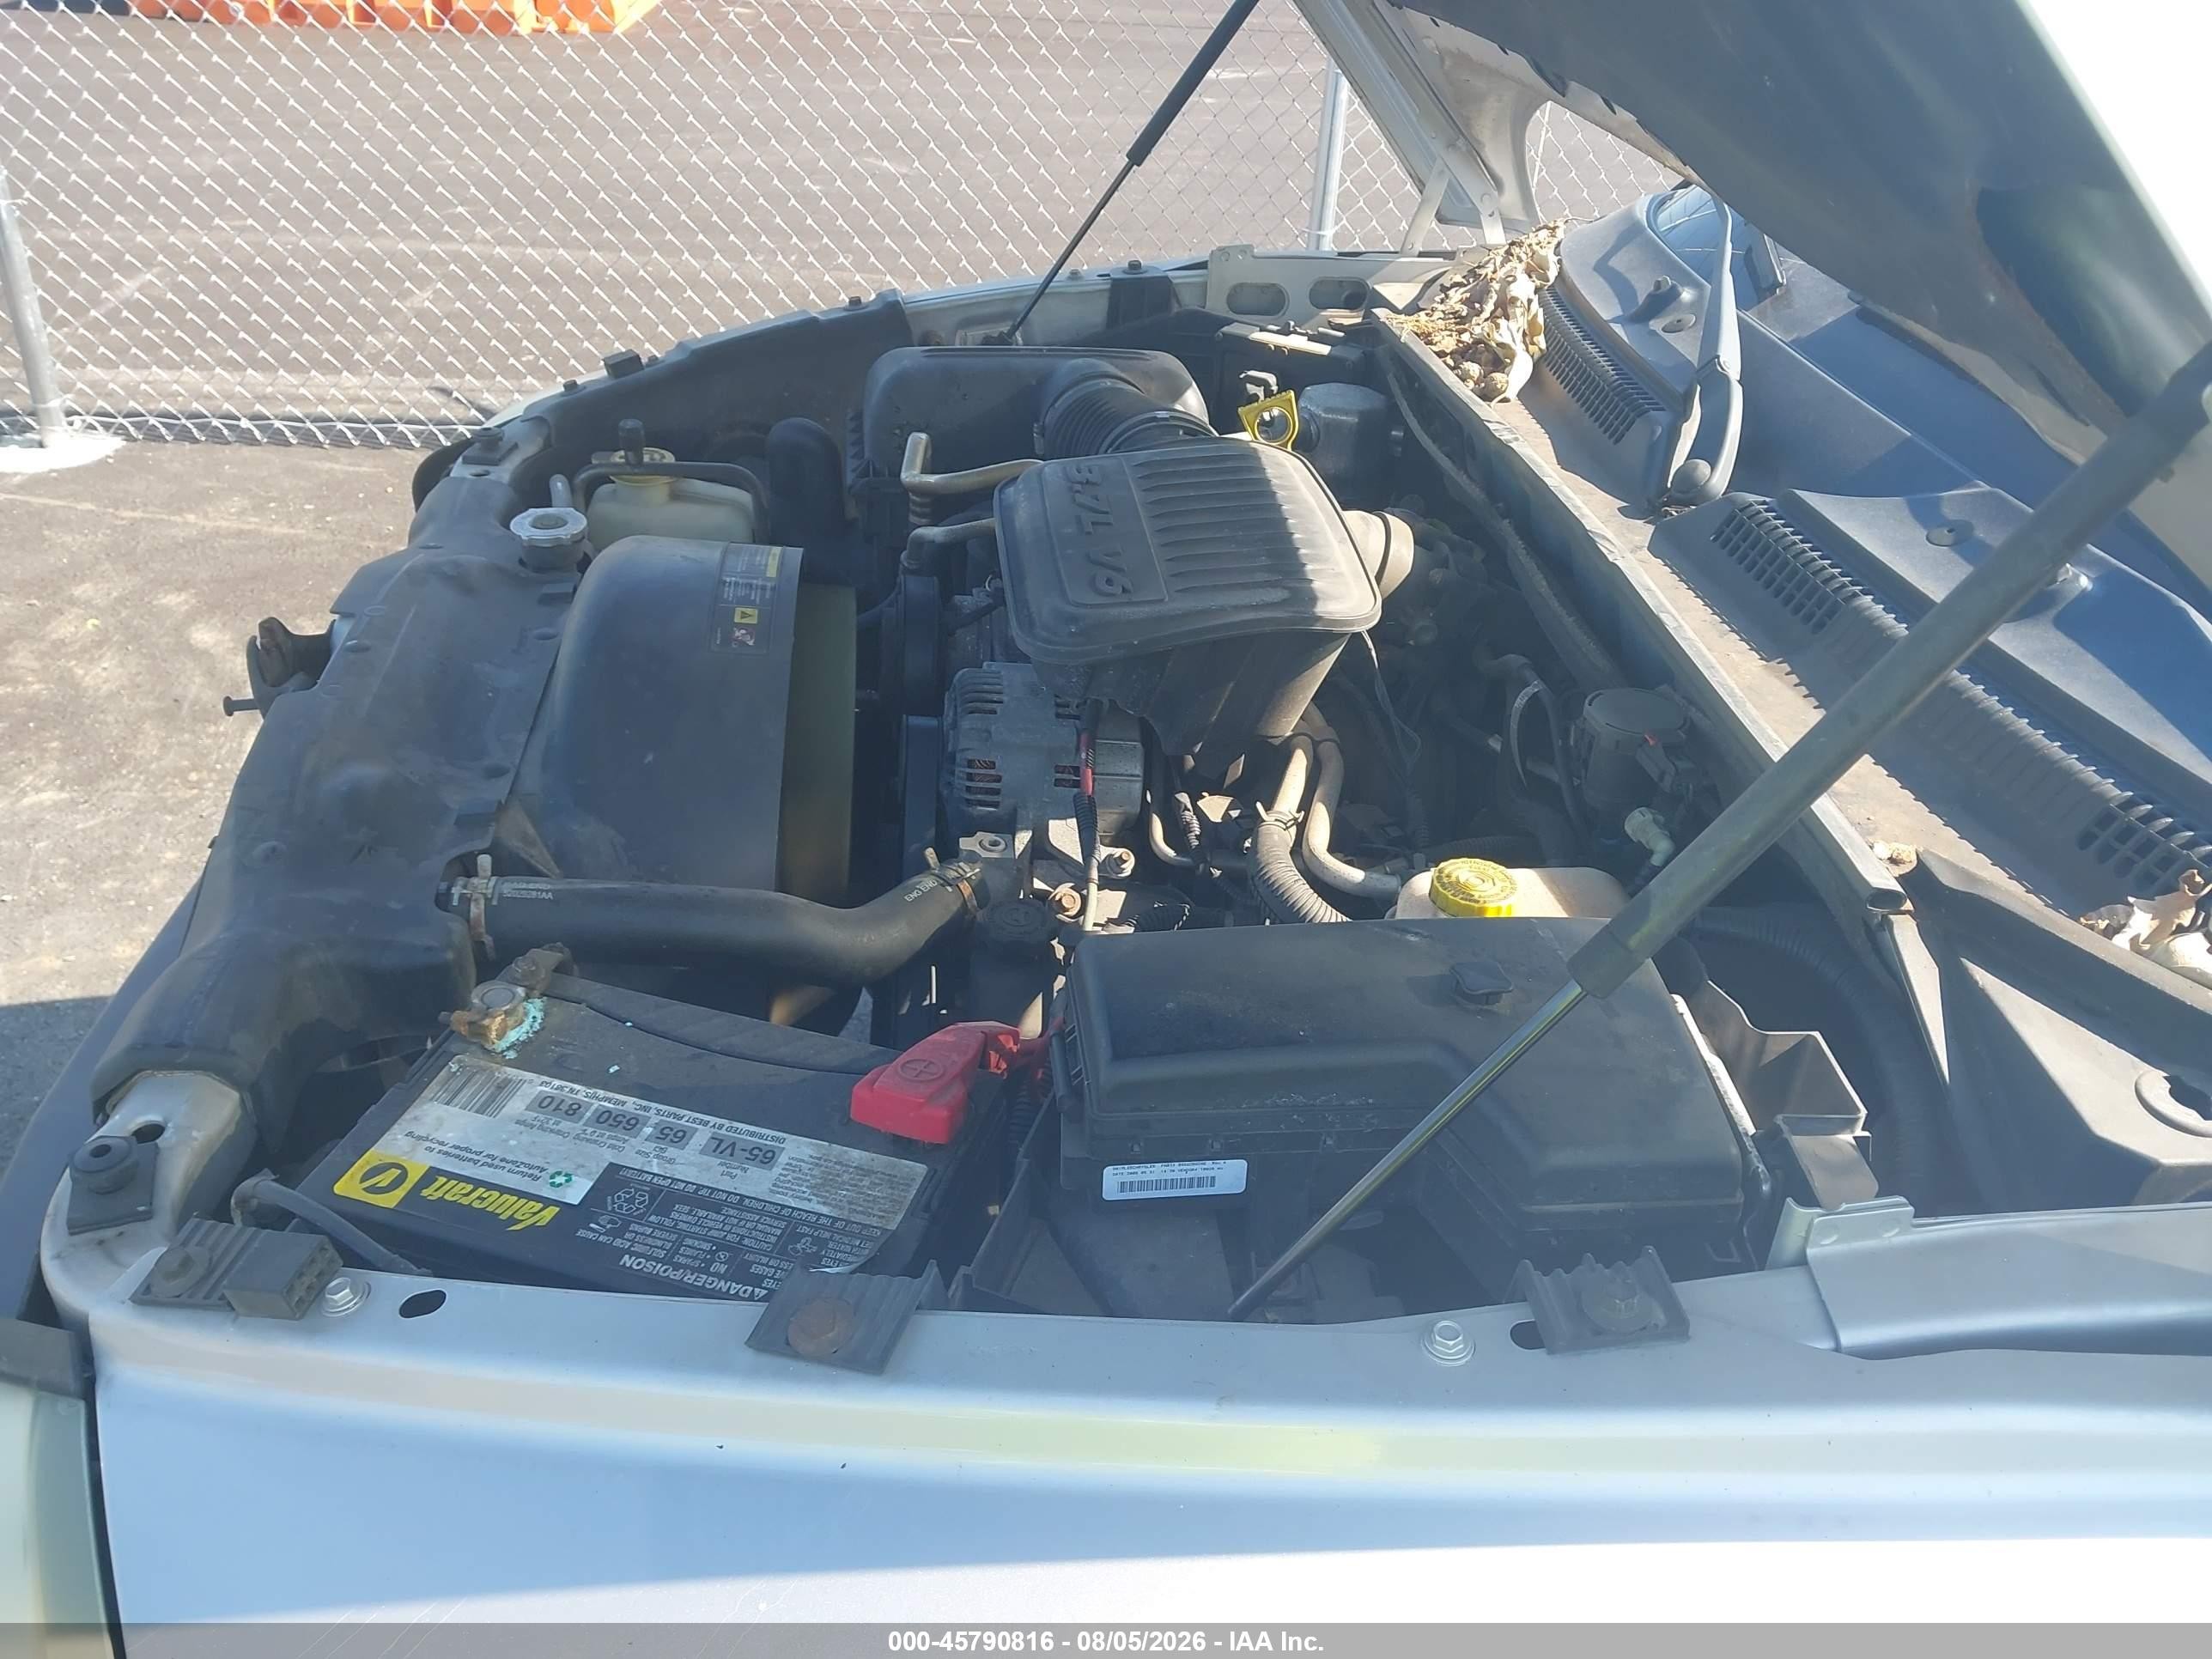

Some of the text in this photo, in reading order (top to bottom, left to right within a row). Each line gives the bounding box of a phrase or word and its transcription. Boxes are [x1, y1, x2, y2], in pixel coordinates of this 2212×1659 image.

[1066, 466, 1133, 596] 3.7L V6
[903, 877, 938, 902] ENG END
[538, 1079, 568, 1092] 38103
[565, 1086, 580, 1096] TN
[535, 1093, 584, 1117] 810
[650, 1105, 685, 1121] PARTS,
[592, 1108, 641, 1132] 650
[684, 1115, 710, 1127] BEST
[708, 1120, 726, 1130] BY
[654, 1124, 689, 1145] 65
[724, 1124, 787, 1144] DISTRIBUTED
[402, 1129, 548, 1174] AutoZone for proper recycling
[607, 1142, 626, 1152] Cold
[703, 1135, 778, 1165] 65-VL
[634, 1148, 677, 1164] Group Size
[422, 1145, 543, 1182] Return used batteries to
[716, 1160, 750, 1173] Number
[651, 1176, 672, 1186] OPEN
[719, 1170, 738, 1180] Part
[684, 1183, 696, 1192] DO
[710, 1190, 728, 1200] NOT
[726, 1194, 740, 1203] DO
[420, 1176, 559, 1231] Valucraft
[779, 1206, 793, 1216] OF
[791, 1210, 818, 1222] REACH
[647, 1213, 676, 1226] FOLLOW
[816, 1215, 833, 1225] THE
[832, 1219, 846, 1229] OF
[844, 1222, 862, 1232] OUT
[860, 1226, 882, 1237] KEEP
[574, 1228, 600, 1240] CAUSE
[597, 1234, 614, 1243] CAN
[623, 1231, 636, 1239] OR
[725, 1232, 741, 1242] FOR
[611, 1237, 632, 1249] ACID
[672, 1255, 701, 1267] SPARKS
[708, 1261, 728, 1273] NO
[767, 1258, 781, 1267] OR
[820, 1257, 839, 1267] EYES
[618, 1252, 754, 1298] DANGER/POISON
[748, 1263, 775, 1276] GASES
